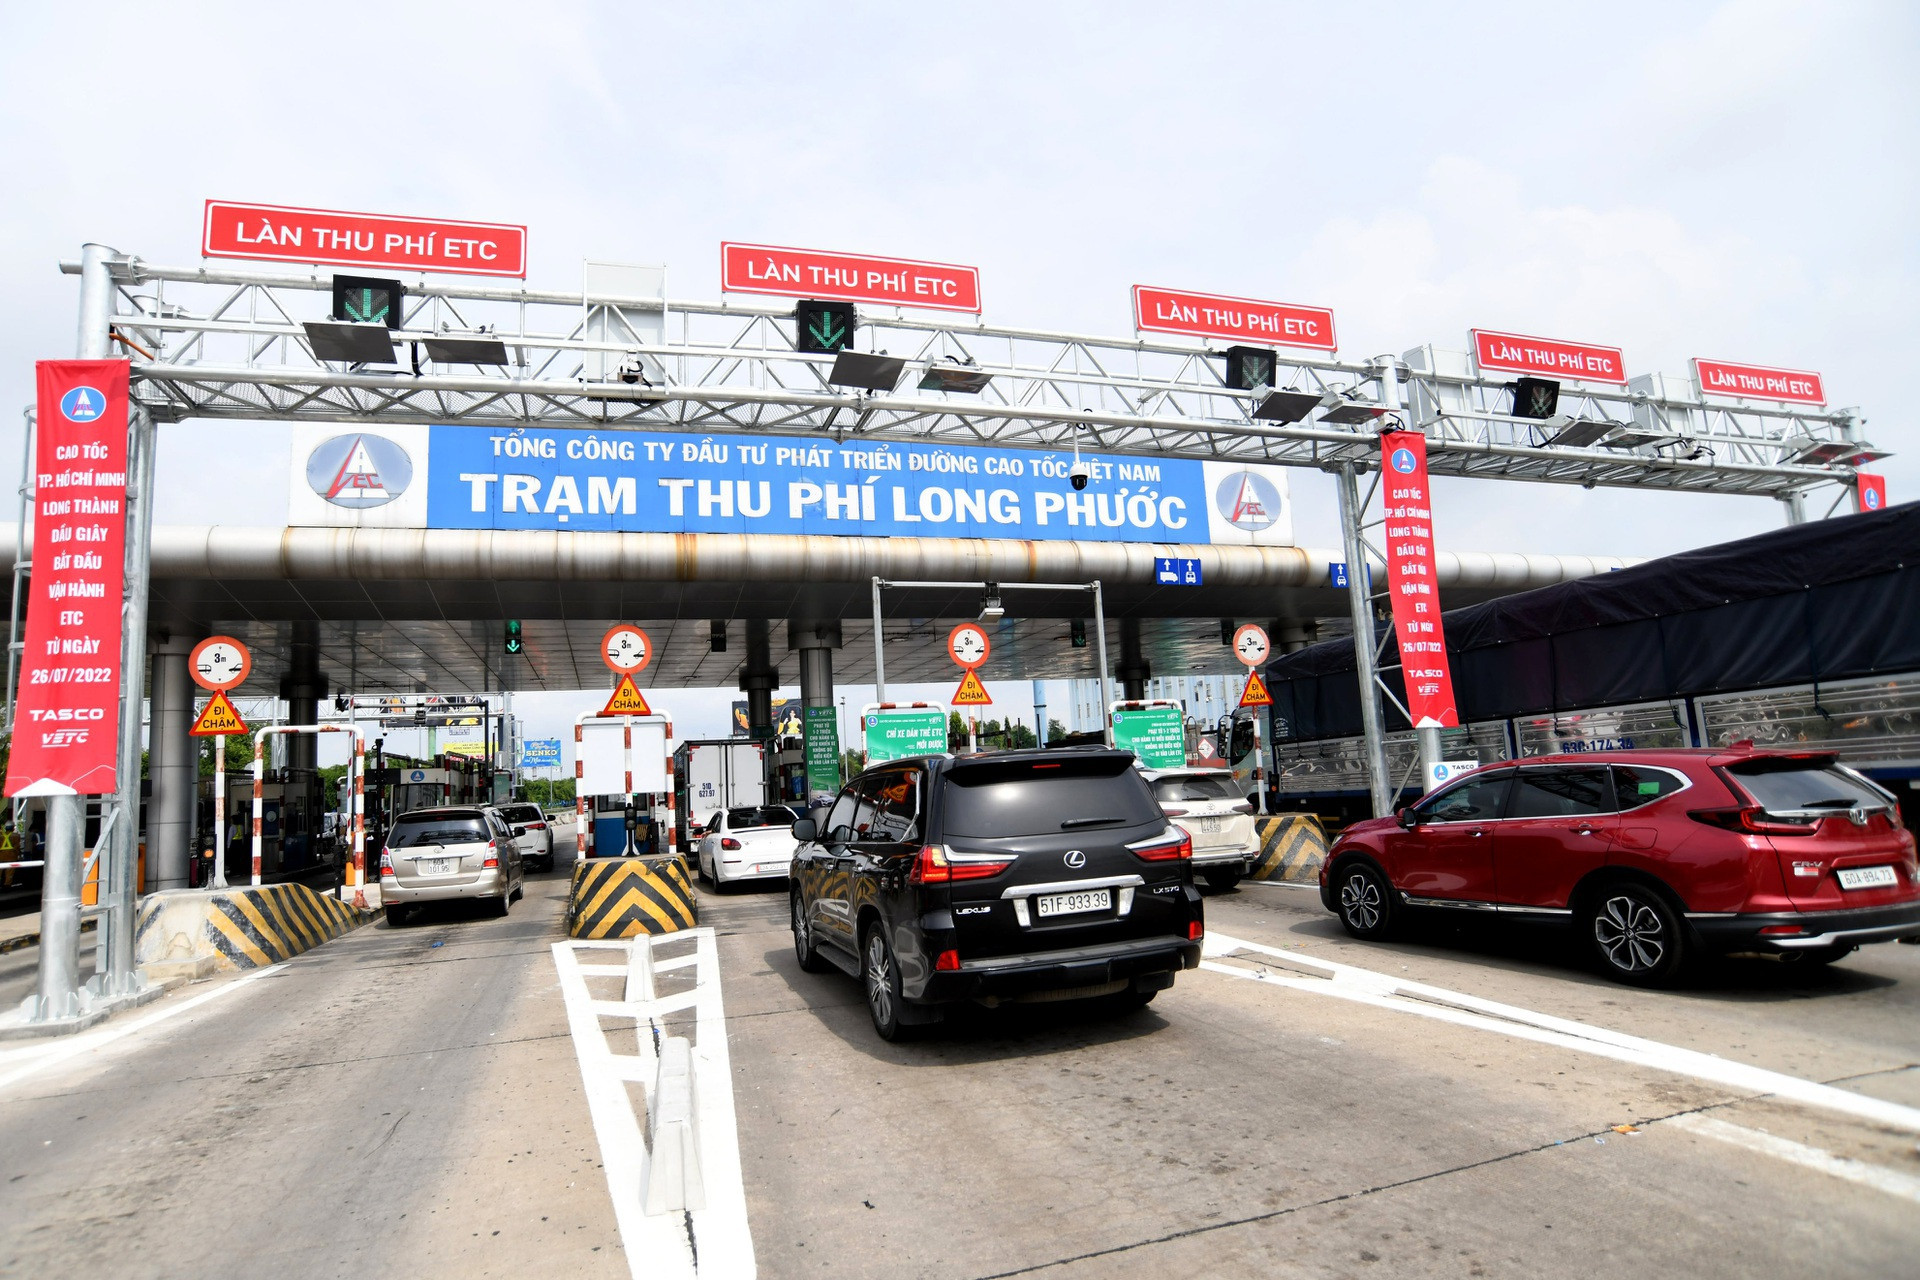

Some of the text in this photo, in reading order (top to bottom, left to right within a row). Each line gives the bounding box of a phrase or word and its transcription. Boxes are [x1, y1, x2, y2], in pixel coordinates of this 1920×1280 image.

[236, 218, 498, 260] LÀN THU PHÍ ETC
[748, 257, 958, 297] LÀN THU PHÍ ETC
[1156, 300, 1318, 337] LÀN THU PHÍ ETC
[1490, 342, 1613, 373] LÀN THU PHÍ ETC
[1709, 369, 1813, 395] LÀN THU PHÍ ETC
[56, 441, 108, 460] CAO TỐC
[490, 428, 1161, 484] TỔNG CÔNG TY ĐẦU TƯ PHÁT TRIỂN ĐƯỜNG CAO TỐC IỆT NAM
[38, 474, 53, 489] TP.
[71, 468, 94, 486] CHÍ
[95, 472, 125, 487] MINH
[43, 496, 119, 516] LONG THÀNH
[460, 473, 1188, 529] TRẠM THU PHÍ LONG PHƯỚC
[75, 523, 109, 542] GIÂY
[1389, 527, 1410, 538] LONG
[53, 549, 72, 571] BẮT
[48, 579, 105, 601] VẬN HÀNH
[1401, 581, 1417, 596] VẬN
[60, 610, 84, 626] ETC
[1406, 620, 1418, 633] TỪ
[46, 635, 100, 655] TỪ NGÀY
[621, 640, 632, 649] 3m
[1246, 637, 1258, 646] 3m
[214, 653, 227, 664] 3m
[30, 667, 112, 685] 26/07/2022
[1408, 669, 1443, 678] TASCO
[623, 689, 632, 697] ĐI
[214, 706, 225, 716] ĐI
[613, 698, 641, 711] CHẬM
[29, 708, 105, 722] TASCO
[202, 717, 235, 730] CHẬM
[41, 731, 89, 746] VETC
[886, 726, 943, 739] CHỈ XE DÁN THẺ ETC
[702, 782, 712, 790] 51D
[955, 906, 991, 915] LEXUS
[1040, 892, 1109, 914] 51F-933.39
